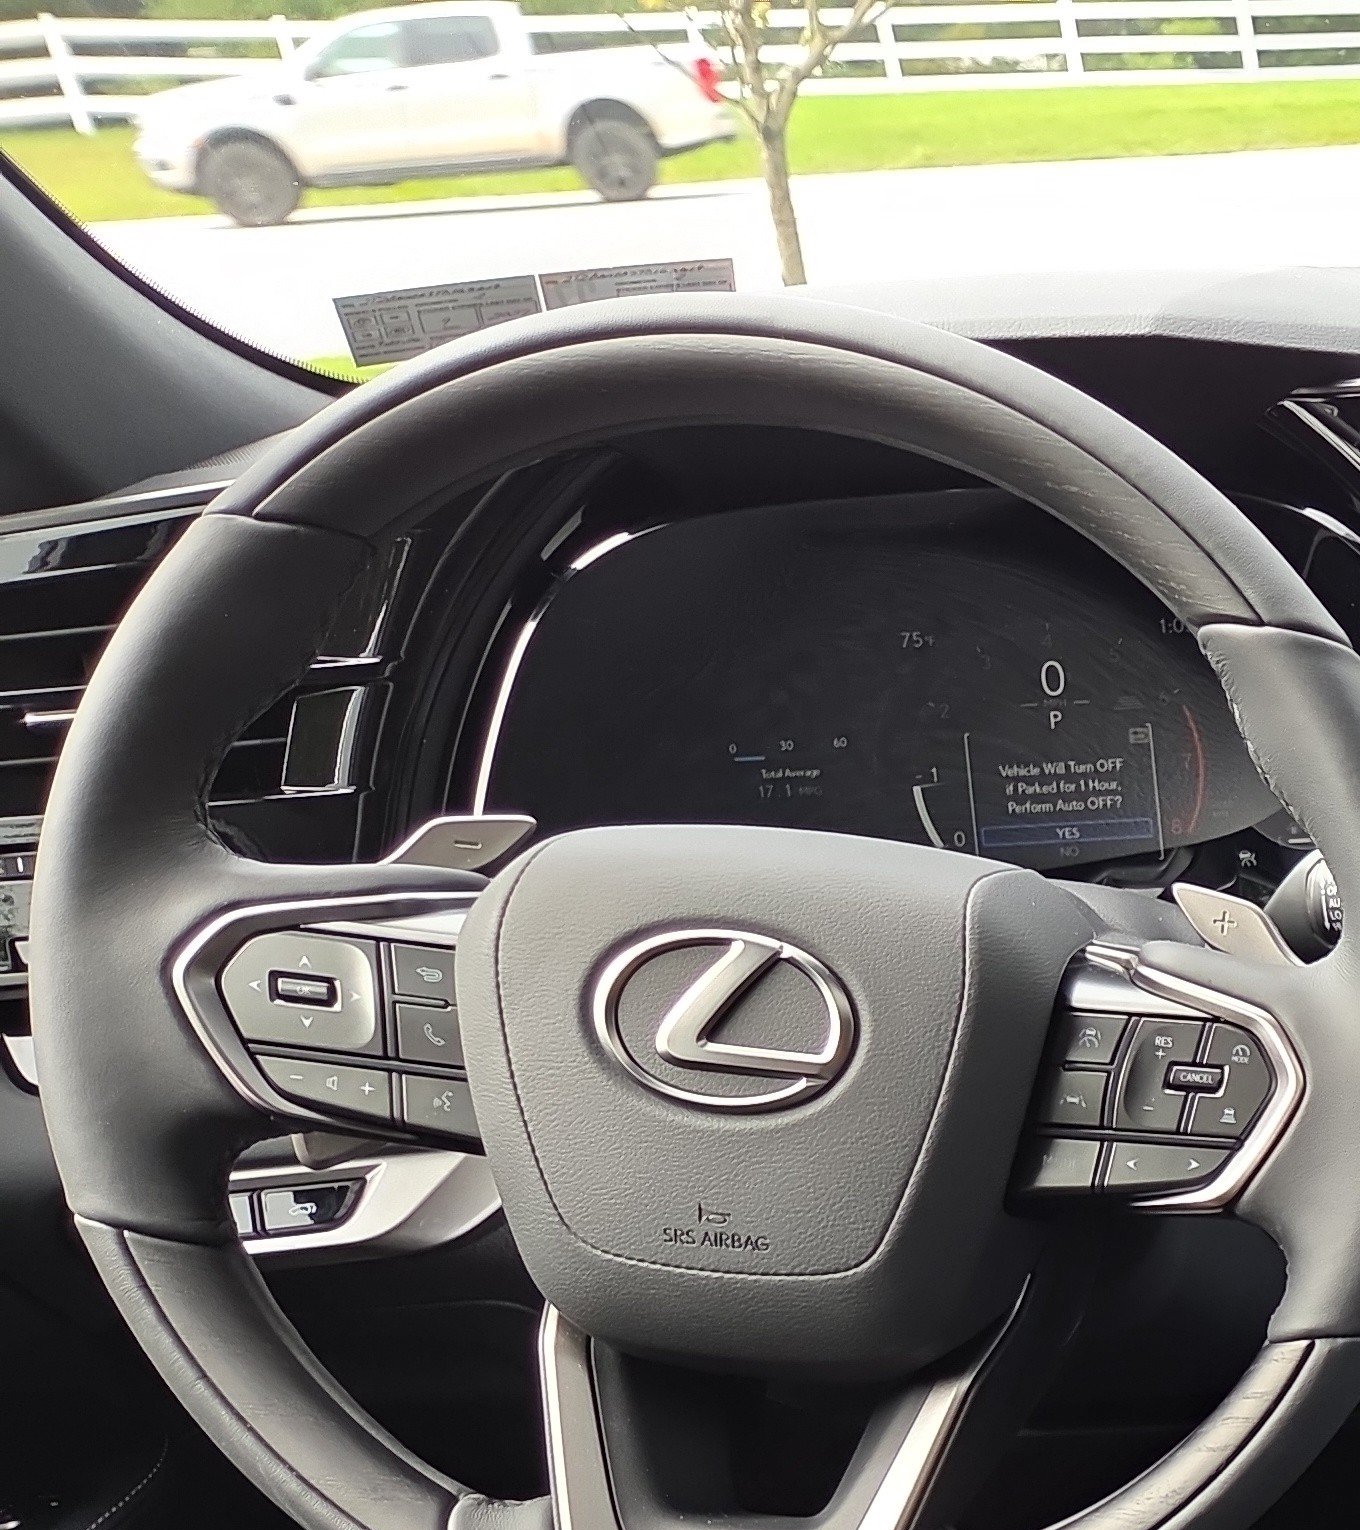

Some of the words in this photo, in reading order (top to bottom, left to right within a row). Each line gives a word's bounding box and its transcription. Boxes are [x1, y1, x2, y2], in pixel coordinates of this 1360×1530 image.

[1040, 659, 1065, 697] 0
[1049, 710, 1063, 730] P
[999, 763, 1041, 777] Vehicle
[1042, 761, 1066, 776] Will
[1067, 760, 1095, 774] Turn
[1096, 758, 1124, 773] OFF
[1017, 780, 1058, 795] Parked
[1059, 779, 1077, 793] for
[1007, 800, 1054, 815] Perform
[1056, 798, 1086, 812] Auto
[1086, 795, 1123, 811] OFF?
[1056, 827, 1080, 840] YES
[1154, 1035, 1174, 1049] RES
[1179, 1072, 1214, 1085] CANCEL
[662, 1226, 697, 1246] SRS
[700, 1230, 770, 1252] AIRBAG
